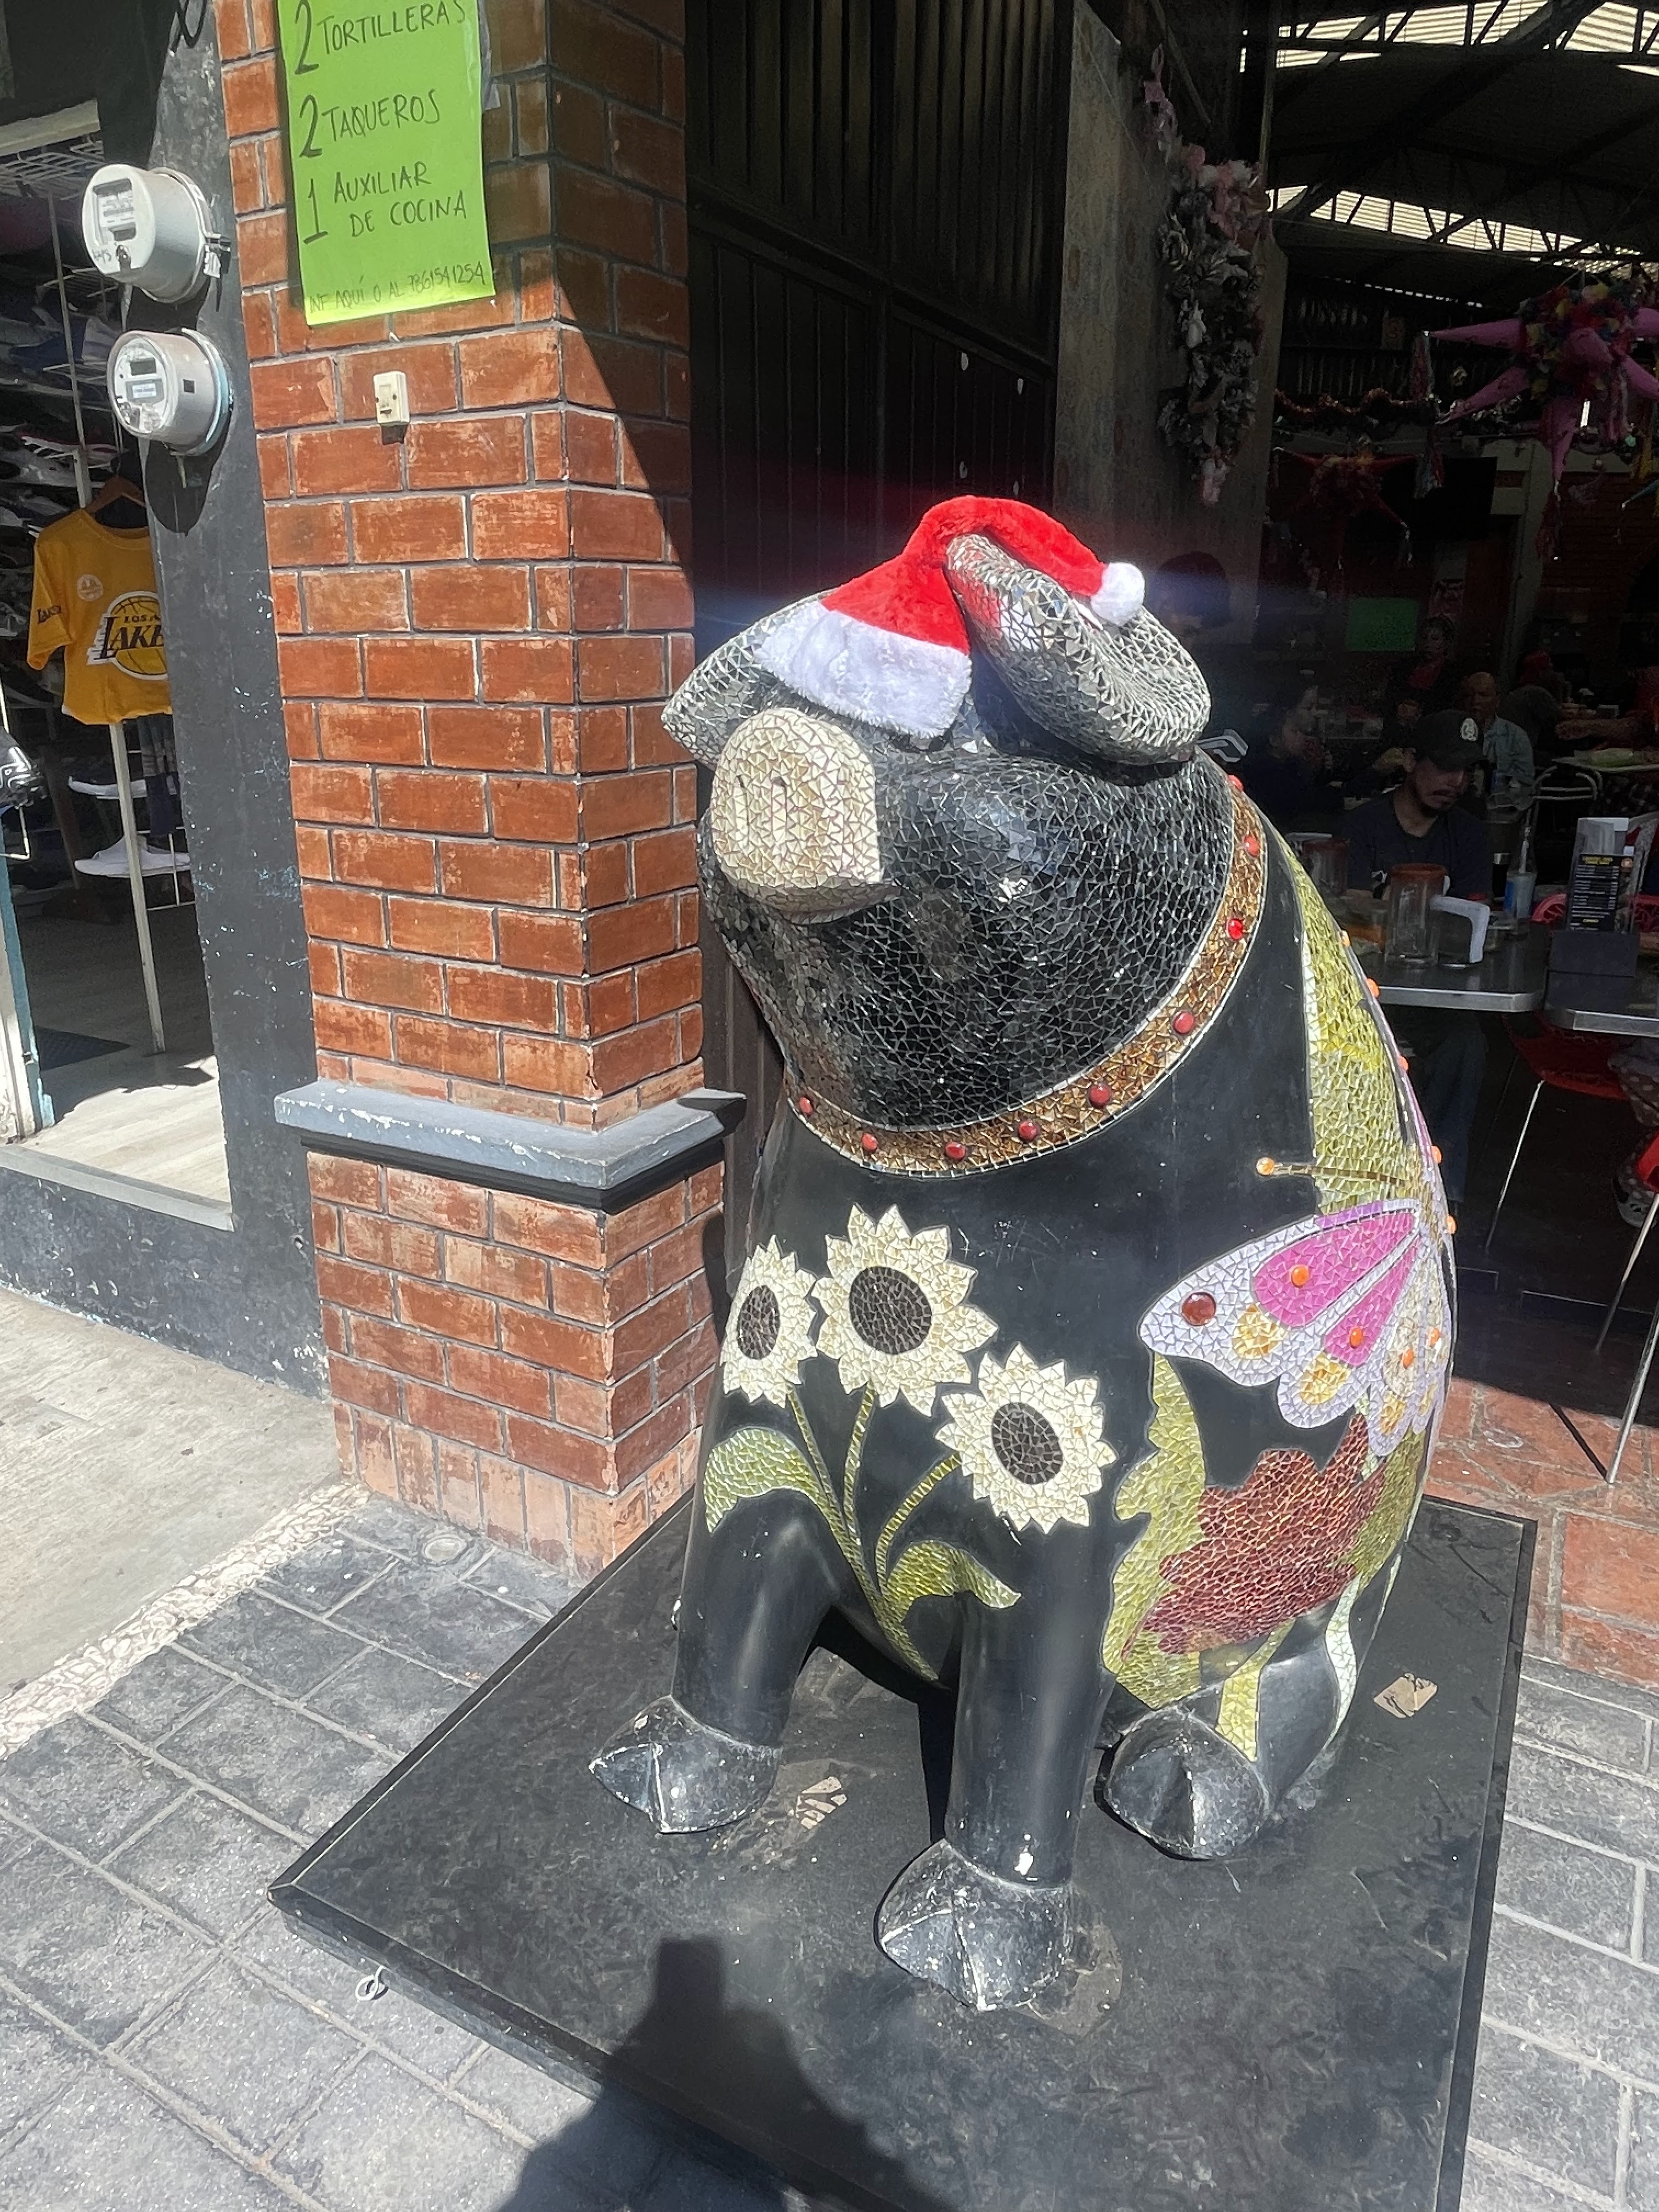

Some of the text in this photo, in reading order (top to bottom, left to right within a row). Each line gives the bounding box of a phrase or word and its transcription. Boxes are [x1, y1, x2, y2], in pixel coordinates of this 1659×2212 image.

[294, 0, 466, 75] 2 TORTILLERAS
[298, 89, 441, 159] 2 TAQUEROS
[303, 160, 432, 244] 1 AUXILIAR
[350, 190, 467, 238] DE COCINA
[389, 281, 404, 299] AL
